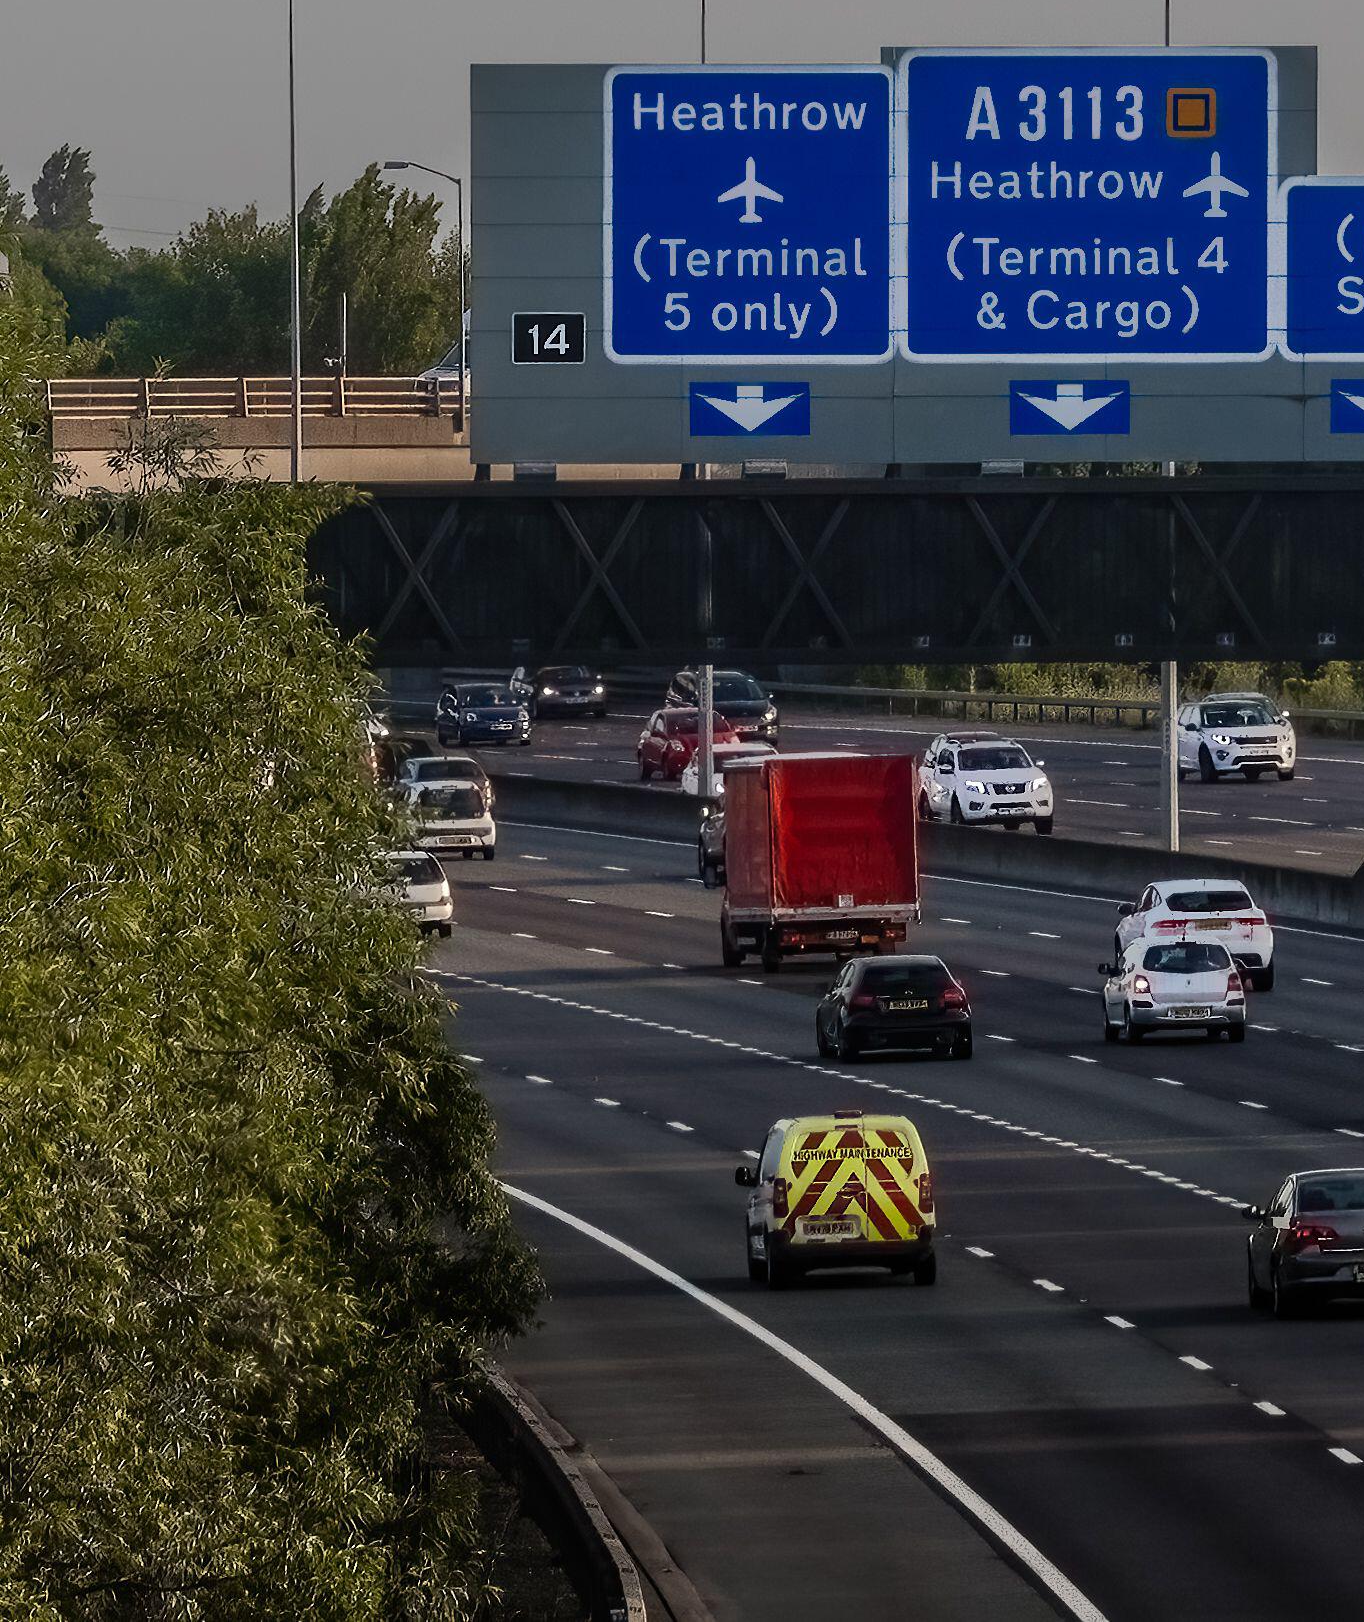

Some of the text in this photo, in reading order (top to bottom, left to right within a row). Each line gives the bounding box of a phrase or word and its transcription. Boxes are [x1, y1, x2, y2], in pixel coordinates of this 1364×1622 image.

[633, 92, 867, 131] Heathrow
[931, 160, 1164, 200] Heathrow
[633, 232, 867, 283] (Terminal
[946, 231, 1230, 281] (Terminal 4
[663, 286, 838, 339] 5 only)
[976, 284, 1200, 338] & Cargo)
[527, 323, 570, 355] 14
[793, 1147, 911, 1161] HIGHWAY MAINTENANCE
